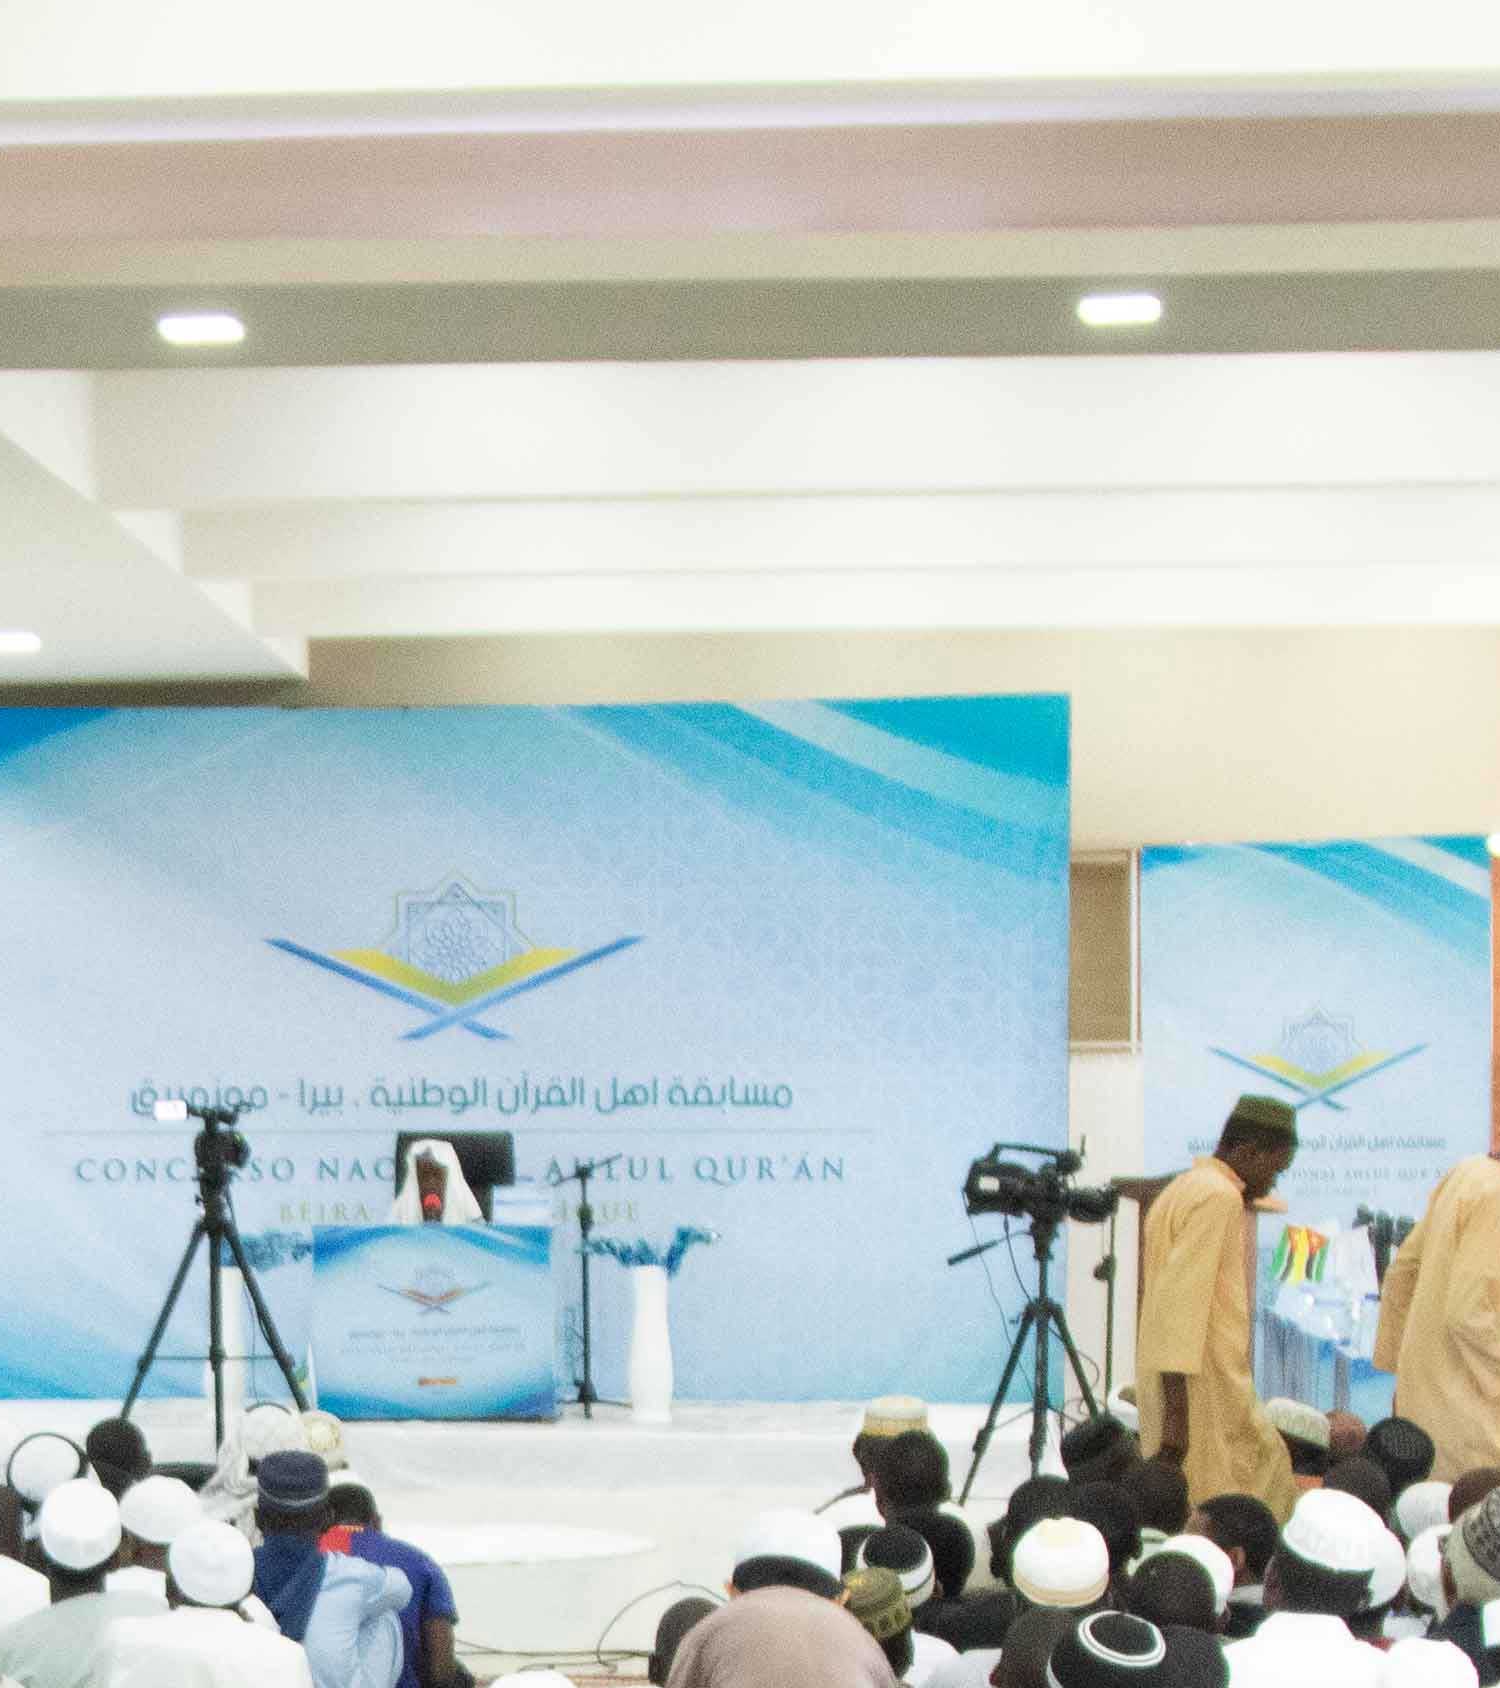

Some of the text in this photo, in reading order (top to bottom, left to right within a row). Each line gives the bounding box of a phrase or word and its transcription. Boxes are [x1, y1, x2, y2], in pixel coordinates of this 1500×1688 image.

[299, 1077, 345, 1116] بيرا
[369, 1075, 488, 1115] الوطنية
[497, 1071, 585, 1114] القرآن
[594, 1076, 660, 1114] اهل
[667, 1075, 794, 1113] مسابقة
[74, 1157, 296, 1184] CONCSO
[279, 1203, 372, 1224] BEIRA
